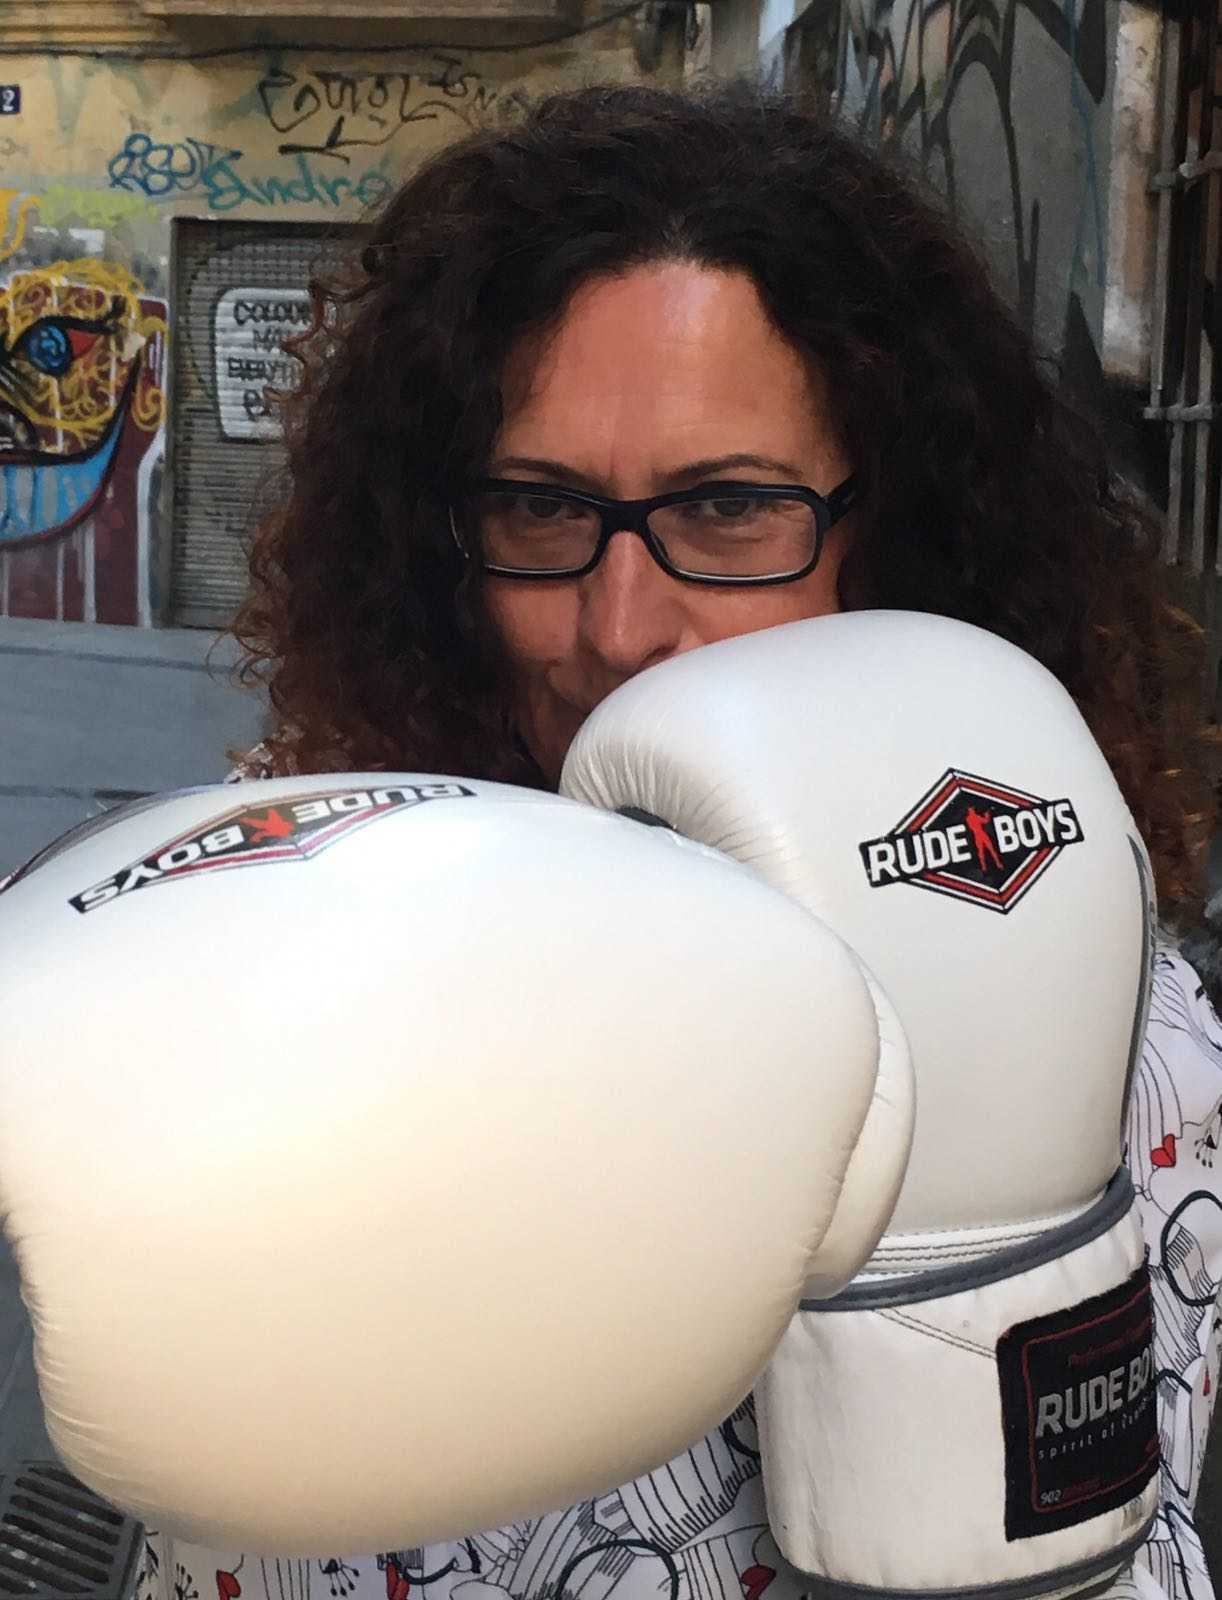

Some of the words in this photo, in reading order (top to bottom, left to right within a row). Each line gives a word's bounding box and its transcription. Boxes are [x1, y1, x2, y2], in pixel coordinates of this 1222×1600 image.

[292, 783, 465, 824] RUDE
[80, 823, 245, 912] BOYS
[867, 823, 972, 883] RUDE
[992, 802, 1079, 854] BOYS
[1035, 1365, 1126, 1438] RUDE
